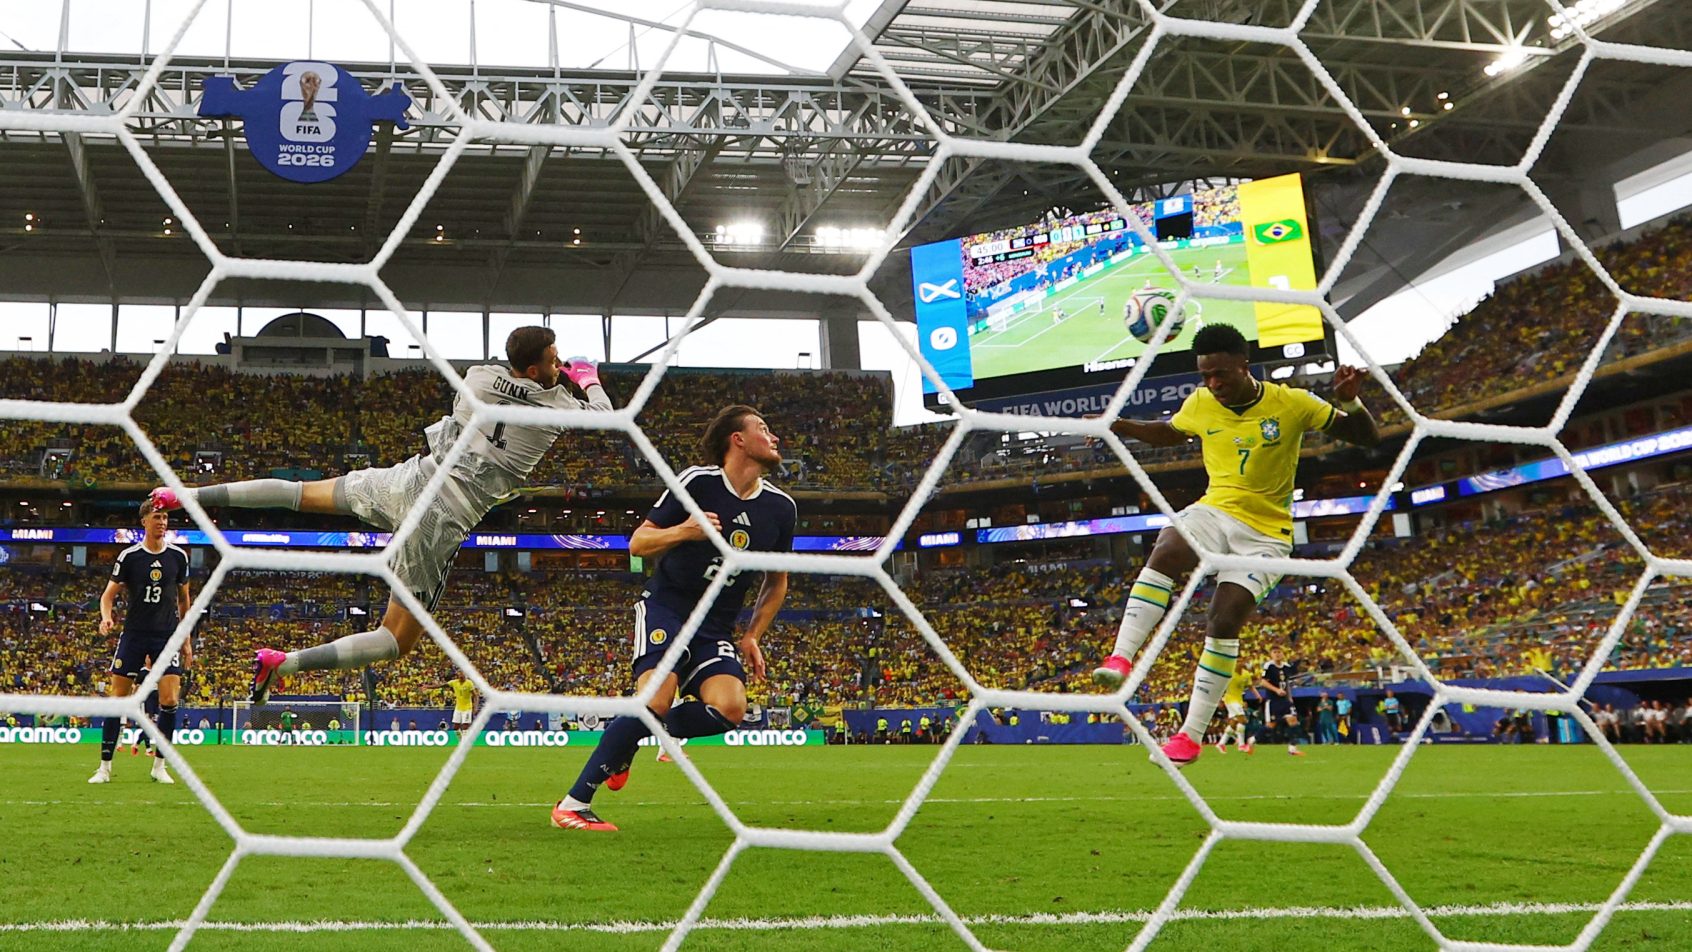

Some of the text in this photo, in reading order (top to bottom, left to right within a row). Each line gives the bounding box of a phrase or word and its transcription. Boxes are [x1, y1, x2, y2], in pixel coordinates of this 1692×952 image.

[296, 125, 320, 134] FIFA
[279, 144, 335, 154] WORLD CUP
[277, 153, 335, 167] 2026
[1083, 358, 1136, 374] Hisense
[492, 375, 530, 401] GUNN
[1044, 394, 1114, 416] WORLD
[1123, 388, 1158, 407] UP
[1238, 448, 1251, 476] 7
[11, 529, 54, 539] MIAMI
[476, 536, 517, 546] MIAMI
[920, 532, 959, 547] MIAMI
[143, 585, 163, 604] 13
[0, 726, 81, 744] aramco
[121, 727, 204, 745] arco
[364, 730, 449, 746] aramco
[485, 730, 569, 746] aramco
[724, 729, 807, 746] aramco
